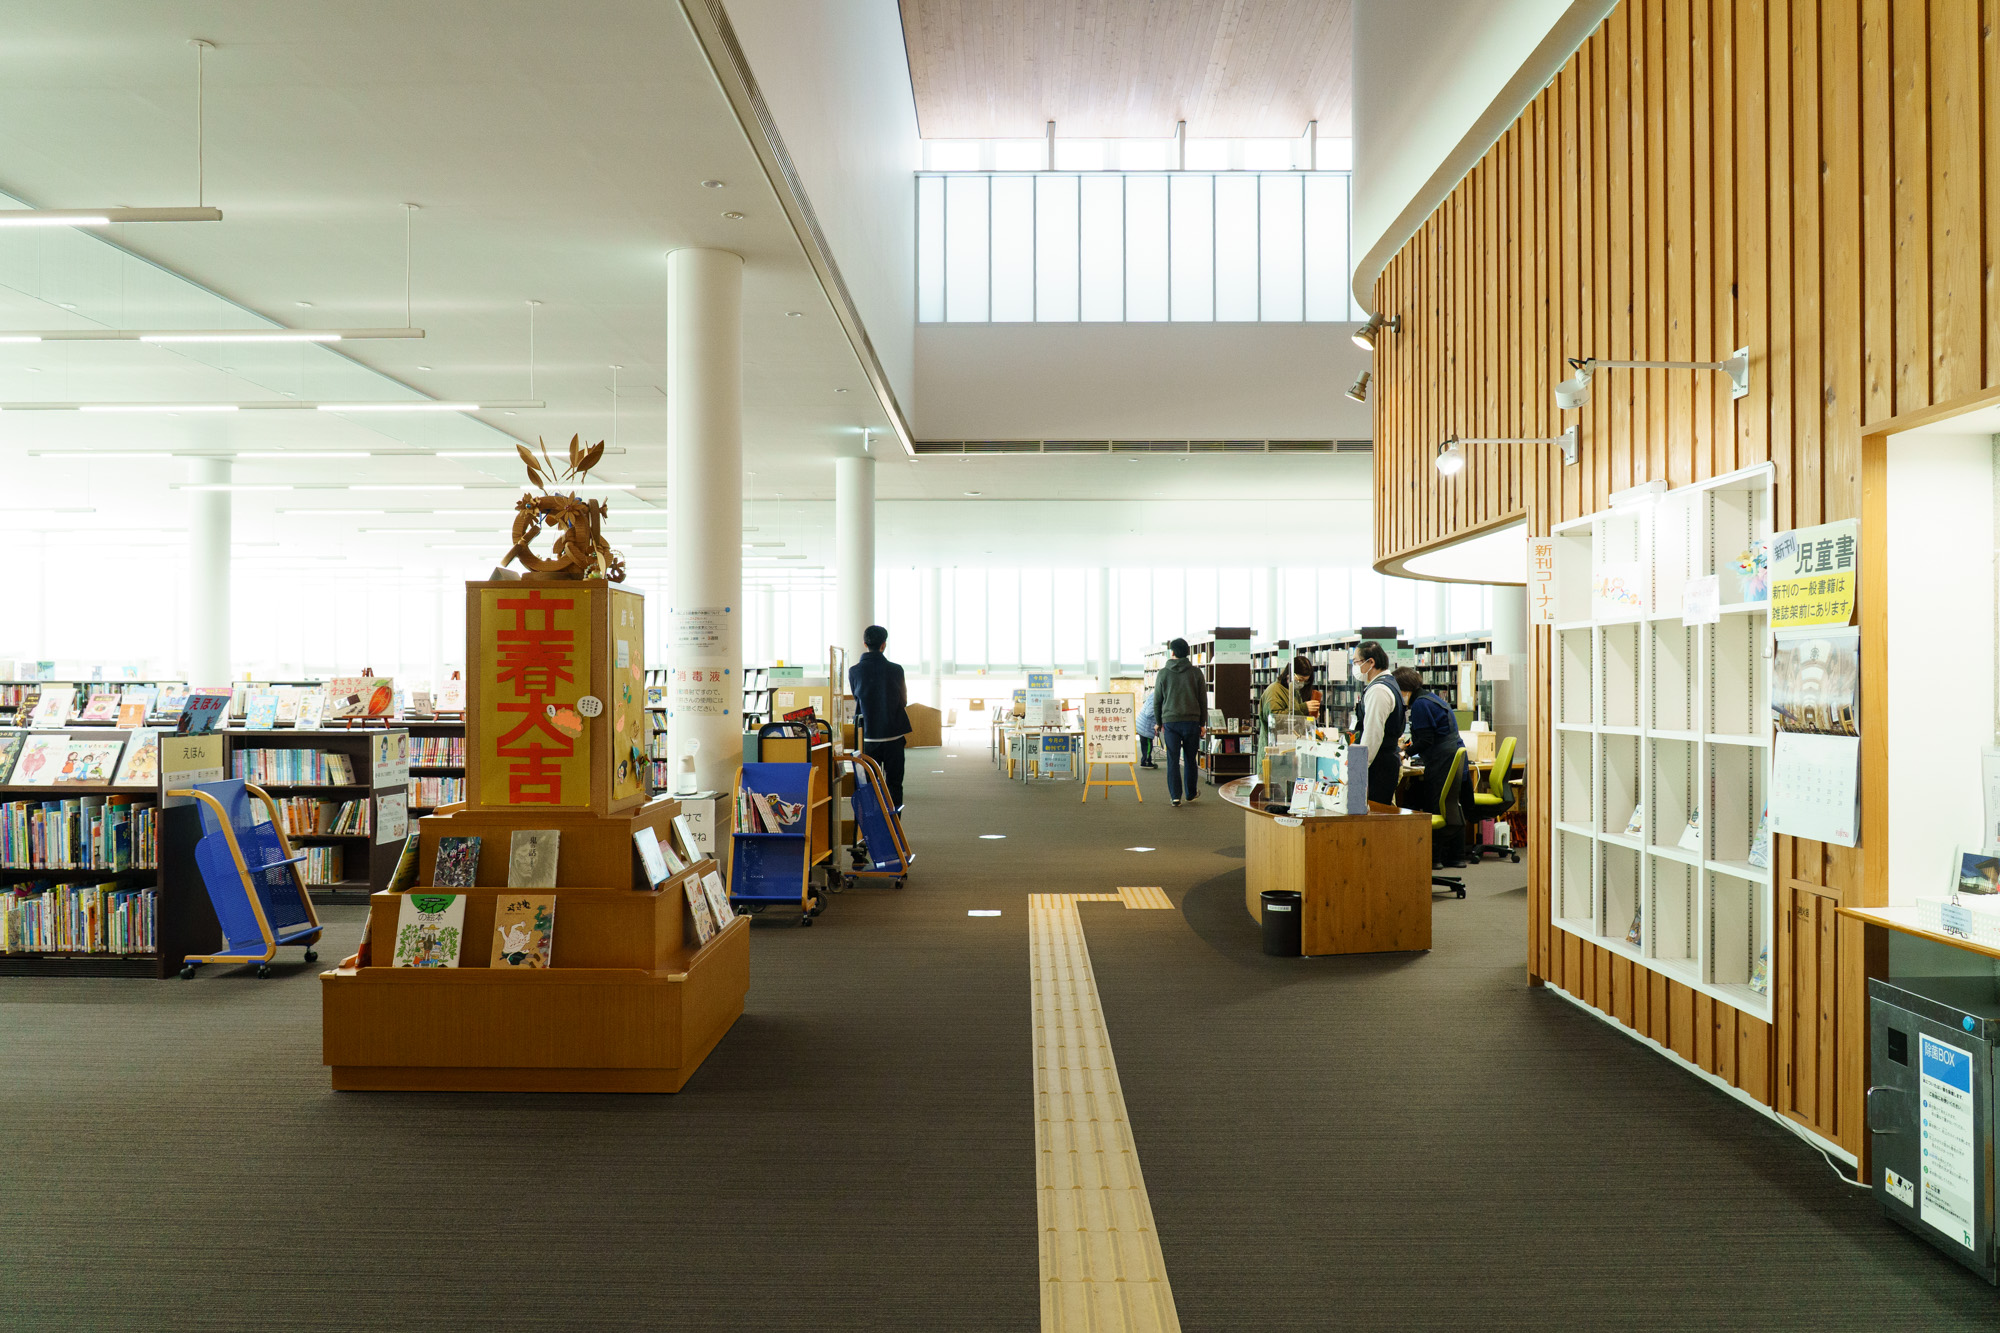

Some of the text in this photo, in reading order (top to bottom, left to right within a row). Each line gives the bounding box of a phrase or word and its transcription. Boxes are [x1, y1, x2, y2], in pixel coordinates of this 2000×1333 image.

[1774, 537, 1795, 560] 新刊
[1794, 534, 1854, 575] 児童書
[1535, 544, 1553, 620] 新刊コーナー
[1773, 578, 1845, 600] 新刊の一般書籍は
[1772, 600, 1851, 621] 雑誌架前にあります。
[677, 671, 720, 682] 消毒液
[330, 686, 372, 696] チョコレート
[497, 590, 574, 804] 立春大吉
[189, 697, 222, 711] えほん
[182, 747, 205, 760] えほん
[416, 901, 449, 914] ダイズ
[418, 913, 443, 922] の絵本
[1924, 1041, 1955, 1067] 除菌BOX
